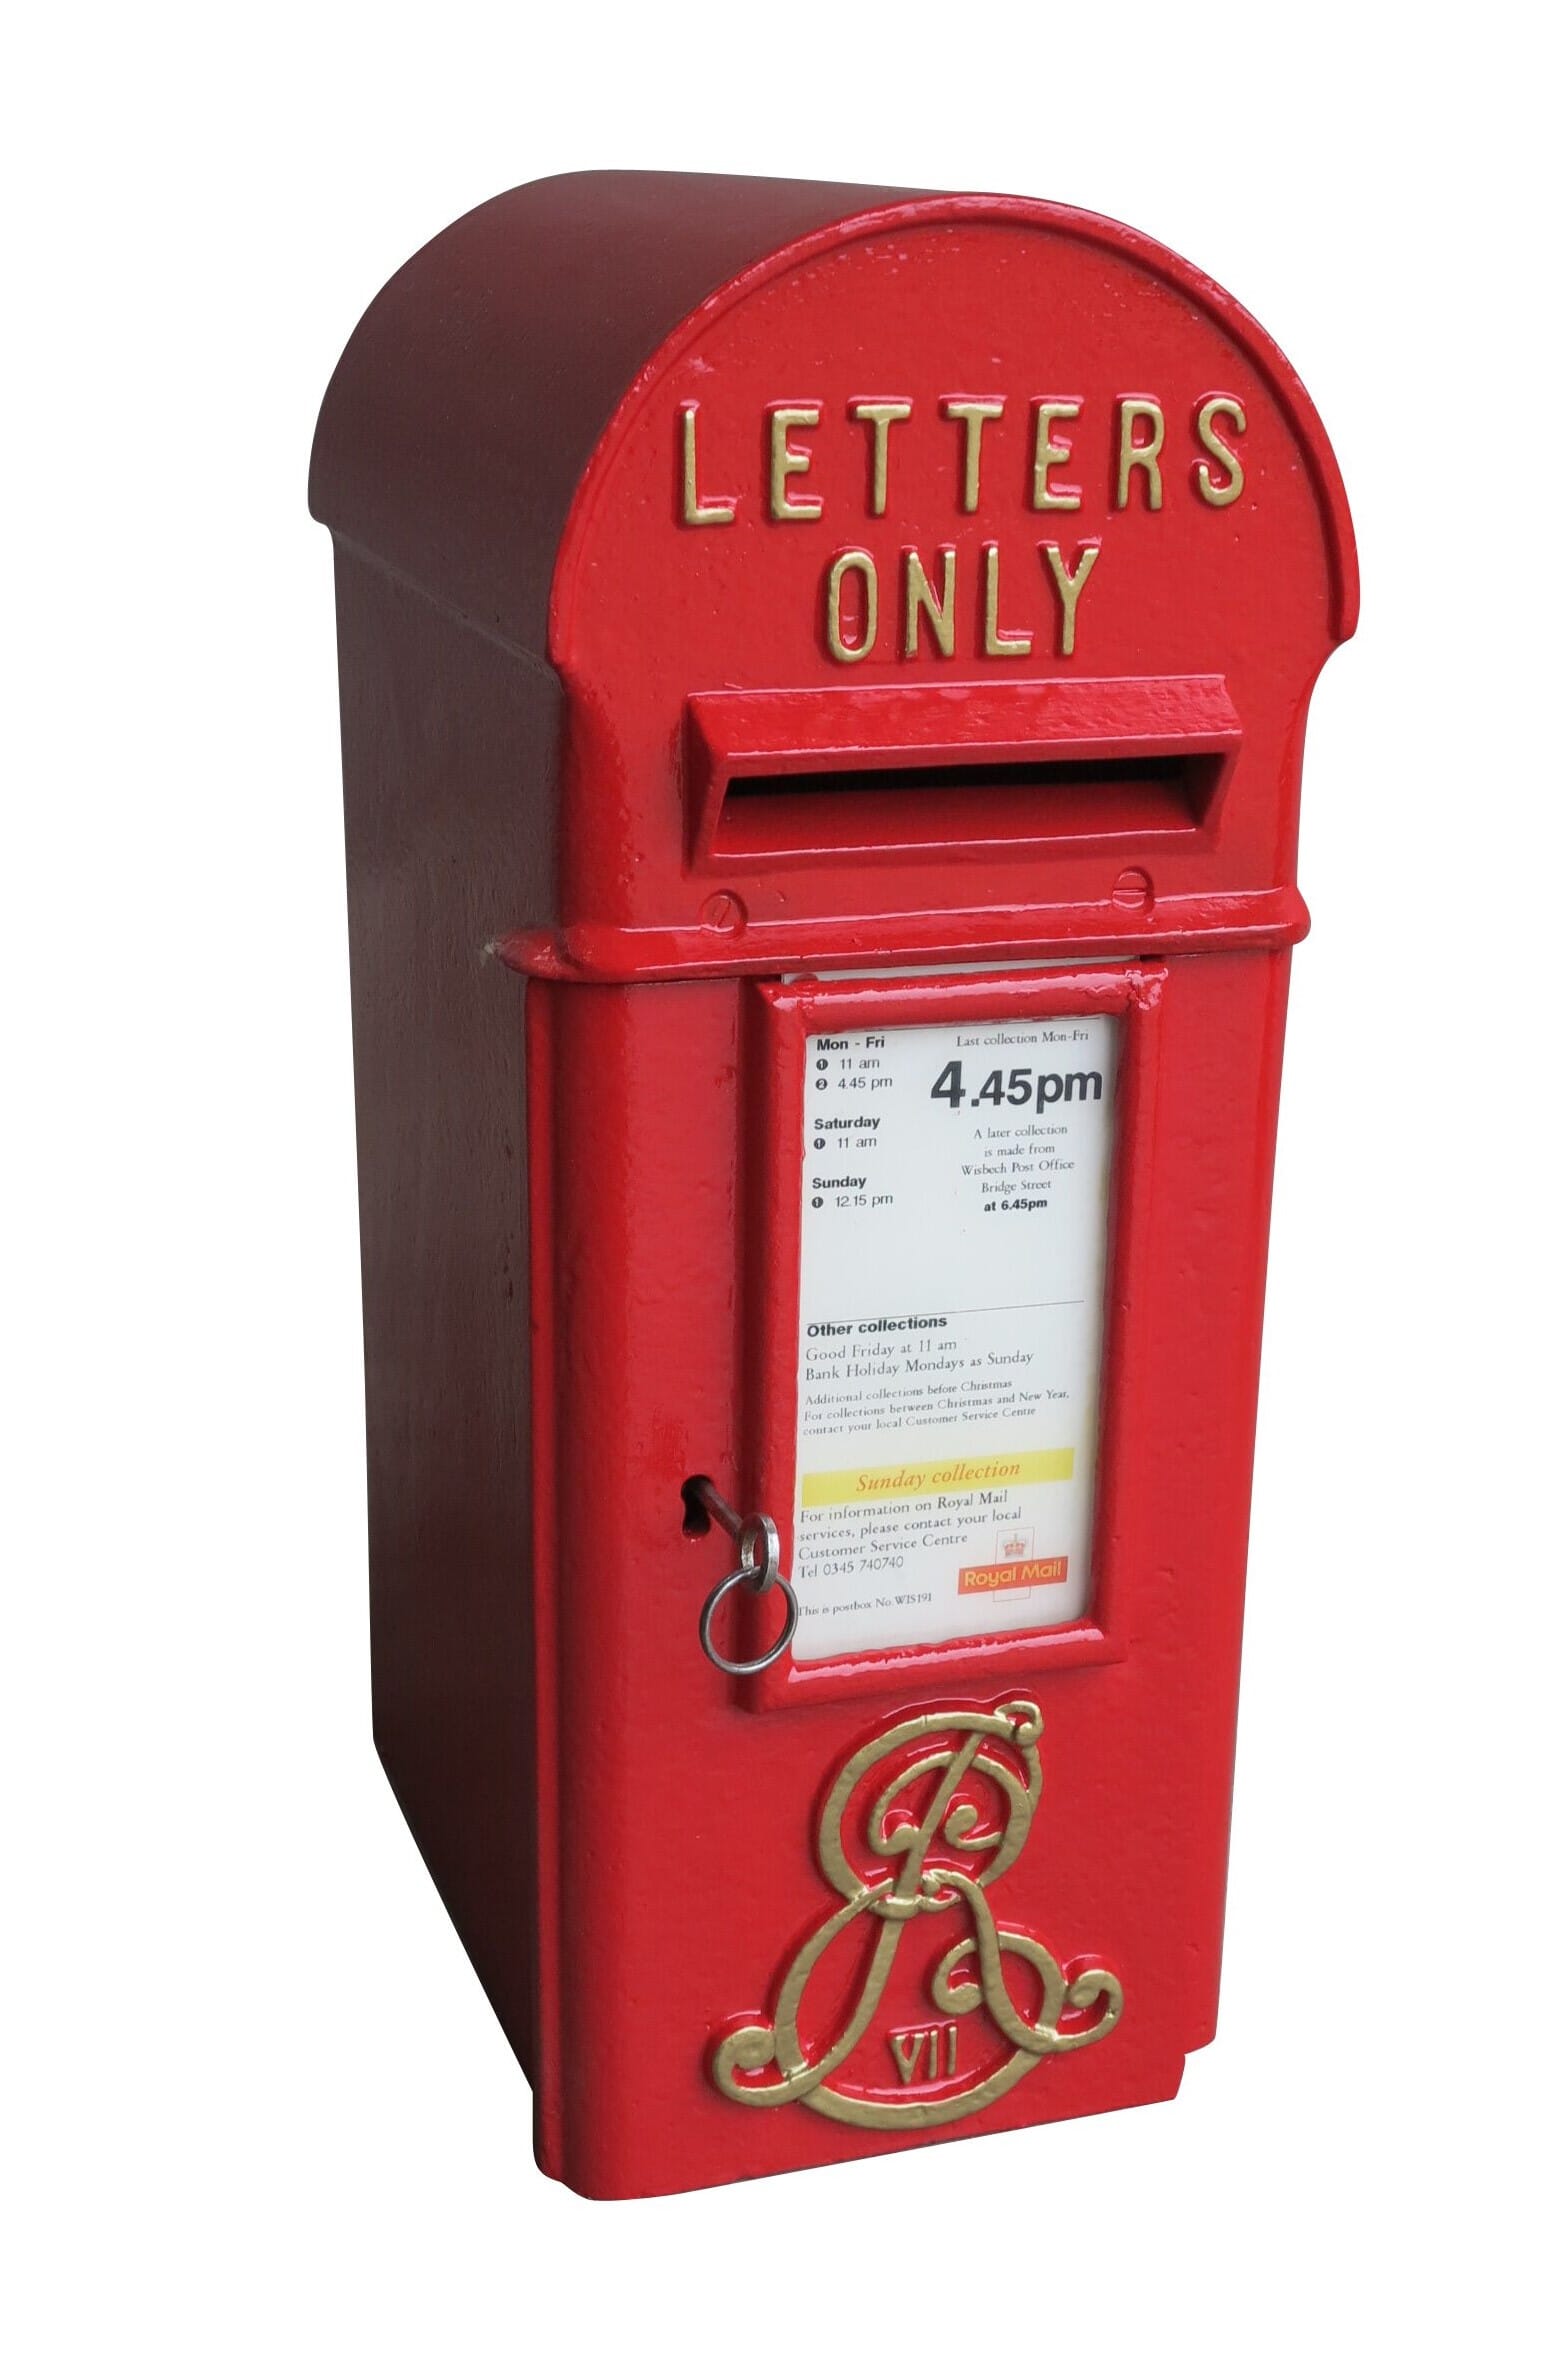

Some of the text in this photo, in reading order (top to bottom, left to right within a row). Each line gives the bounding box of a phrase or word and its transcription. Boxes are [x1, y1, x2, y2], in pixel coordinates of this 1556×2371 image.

[683, 397, 1248, 526] LETTERS
[827, 546, 1100, 664] ONLY
[817, 1039, 848, 1050] Mon
[866, 1036, 885, 1048] Fri
[956, 1030, 1089, 1047] Last collection Mon-Fri
[840, 1059, 852, 1069] 11
[859, 1060, 880, 1069] am
[838, 1077, 866, 1089] 4.45
[871, 1077, 892, 1091] pm
[930, 1060, 1103, 1114] 4.45pm
[814, 1116, 880, 1130] Saturday
[973, 1125, 1068, 1139] A later collection
[837, 1138, 849, 1148] 11
[856, 1138, 877, 1148] am
[984, 1143, 1055, 1157] is made from
[961, 1159, 1075, 1176] Wisbech Post Office
[812, 1176, 867, 1190] Sunday
[981, 1180, 1052, 1195] Bridge Street
[835, 1195, 867, 1207] 12.15
[872, 1194, 893, 1208] pm
[984, 1198, 1048, 1212] at 6.45pm
[807, 1316, 948, 1338] Other collections
[806, 1339, 957, 1361] Good Friday at 11 am
[806, 1350, 1034, 1381] Bank Holiday Mondays as Sunday
[805, 1380, 1012, 1406] Additional collections before Christmas
[804, 1411, 822, 1421] For
[827, 1408, 885, 1420] collections
[890, 1403, 933, 1415] between
[937, 1397, 993, 1410] Christmas
[996, 1393, 1015, 1404] and
[1019, 1391, 1041, 1402] New
[803, 1407, 1036, 1436] contact your local Customer Service Centre
[856, 1461, 1021, 1492] Sunday collection
[800, 1489, 1008, 1524] For information on Royal Mail
[799, 1506, 1022, 1542] services, please contact your local
[798, 1534, 968, 1561] Customer Service Centre
[799, 1556, 904, 1579] Tel 0345 740740
[964, 1560, 1062, 1587] Royal Mail
[797, 1605, 819, 1617] This
[822, 1606, 830, 1615] is
[832, 1600, 872, 1615] postbox
[894, 1592, 933, 1605] WIS191
[889, 2025, 958, 2085] VII
